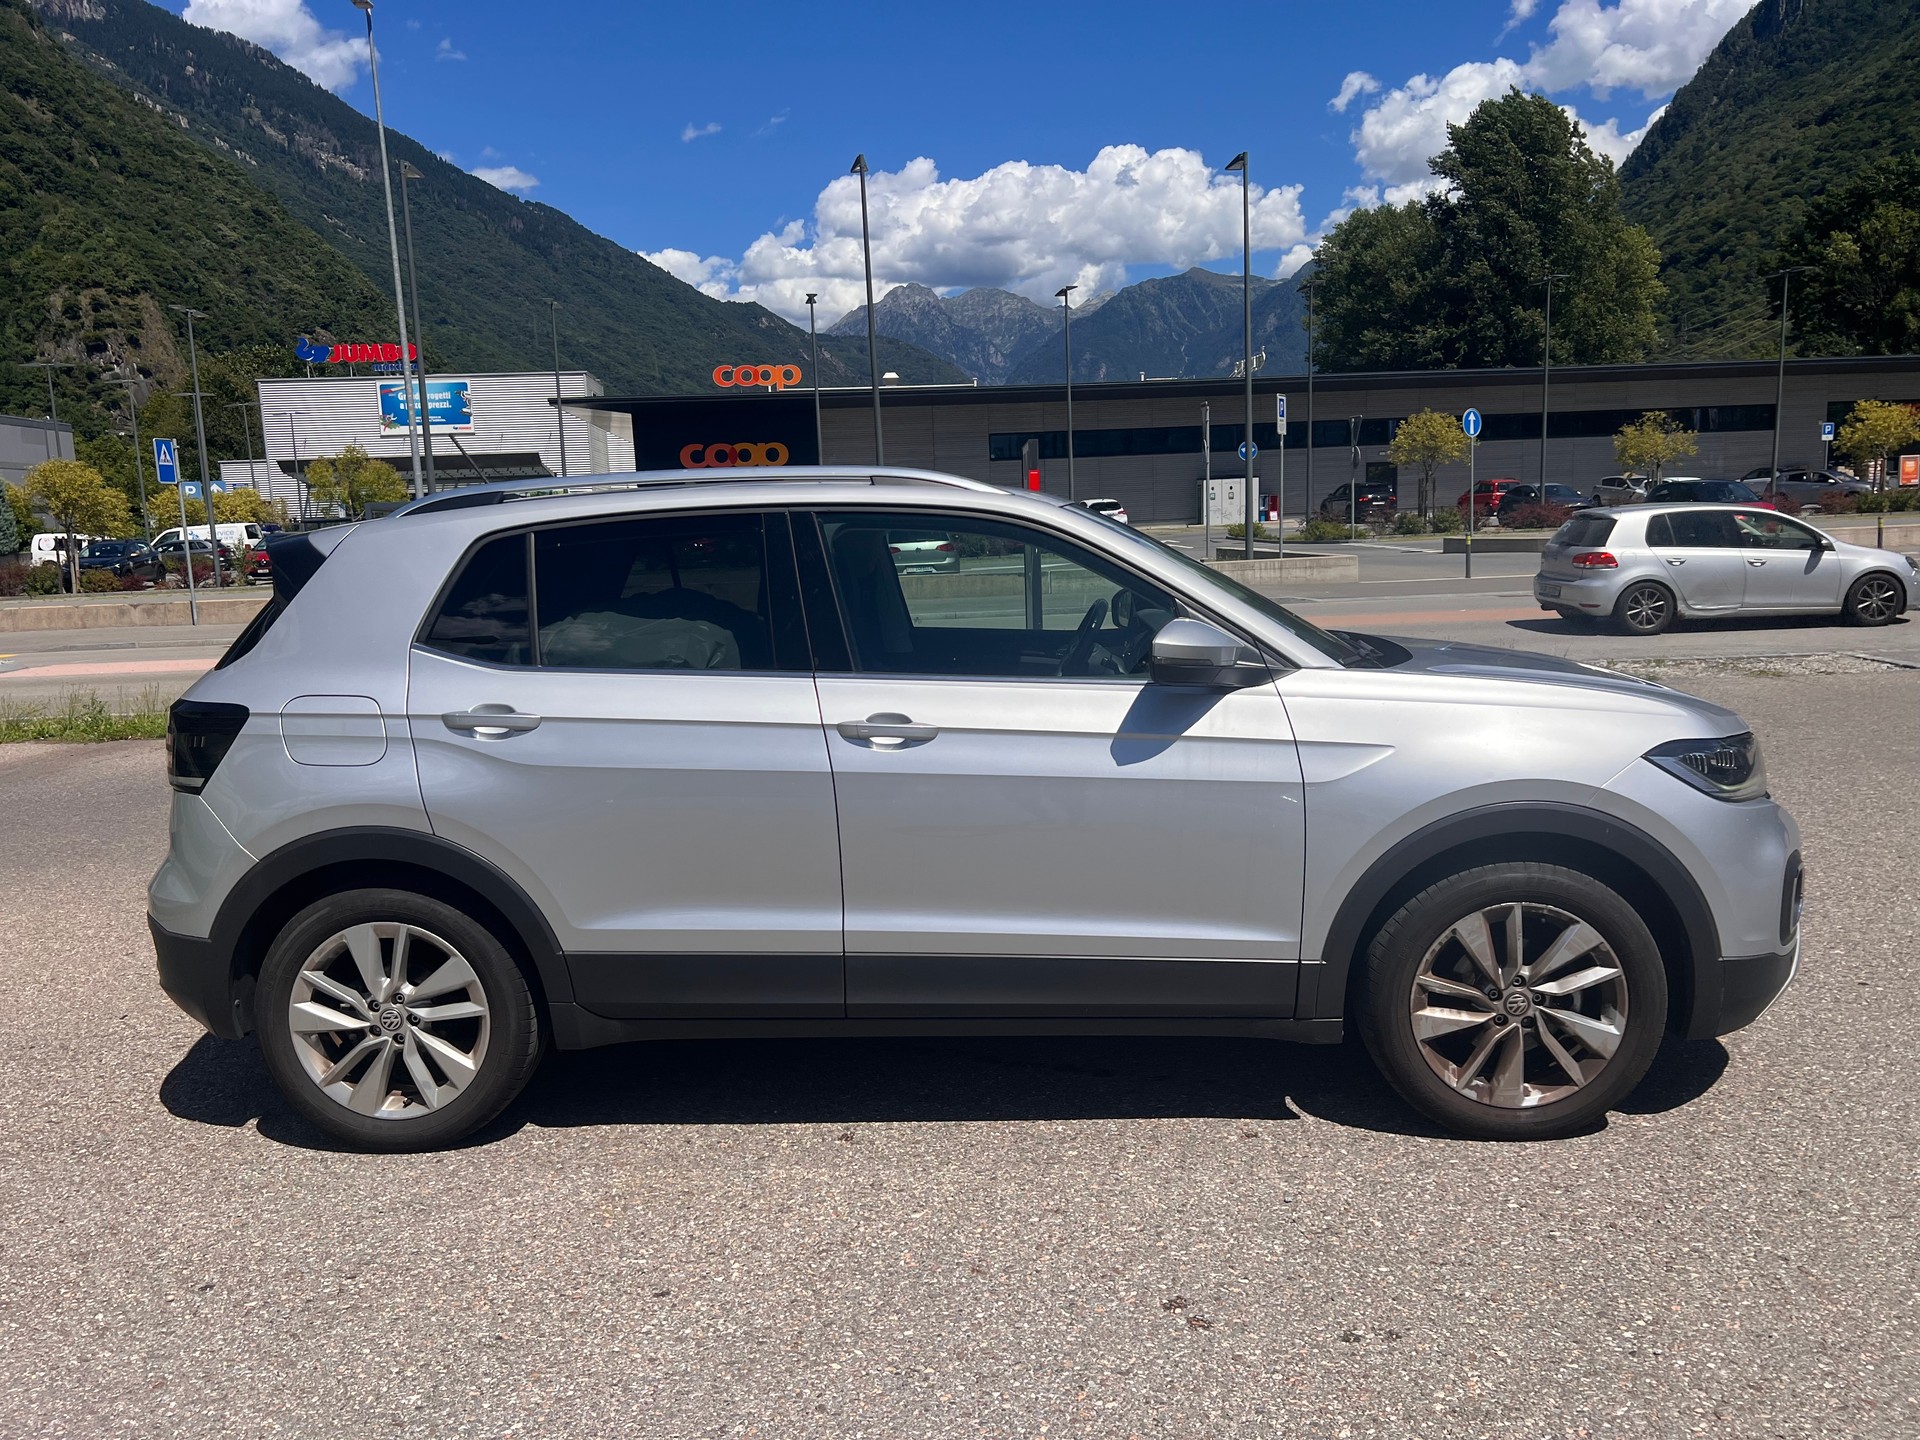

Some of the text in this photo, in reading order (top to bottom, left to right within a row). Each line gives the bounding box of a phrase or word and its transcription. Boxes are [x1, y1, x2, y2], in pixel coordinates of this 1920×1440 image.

[329, 343, 417, 363] JUMBO
[712, 364, 803, 392] coop
[1824, 425, 1832, 434] P
[680, 442, 789, 469] coop
[184, 485, 197, 496] P
